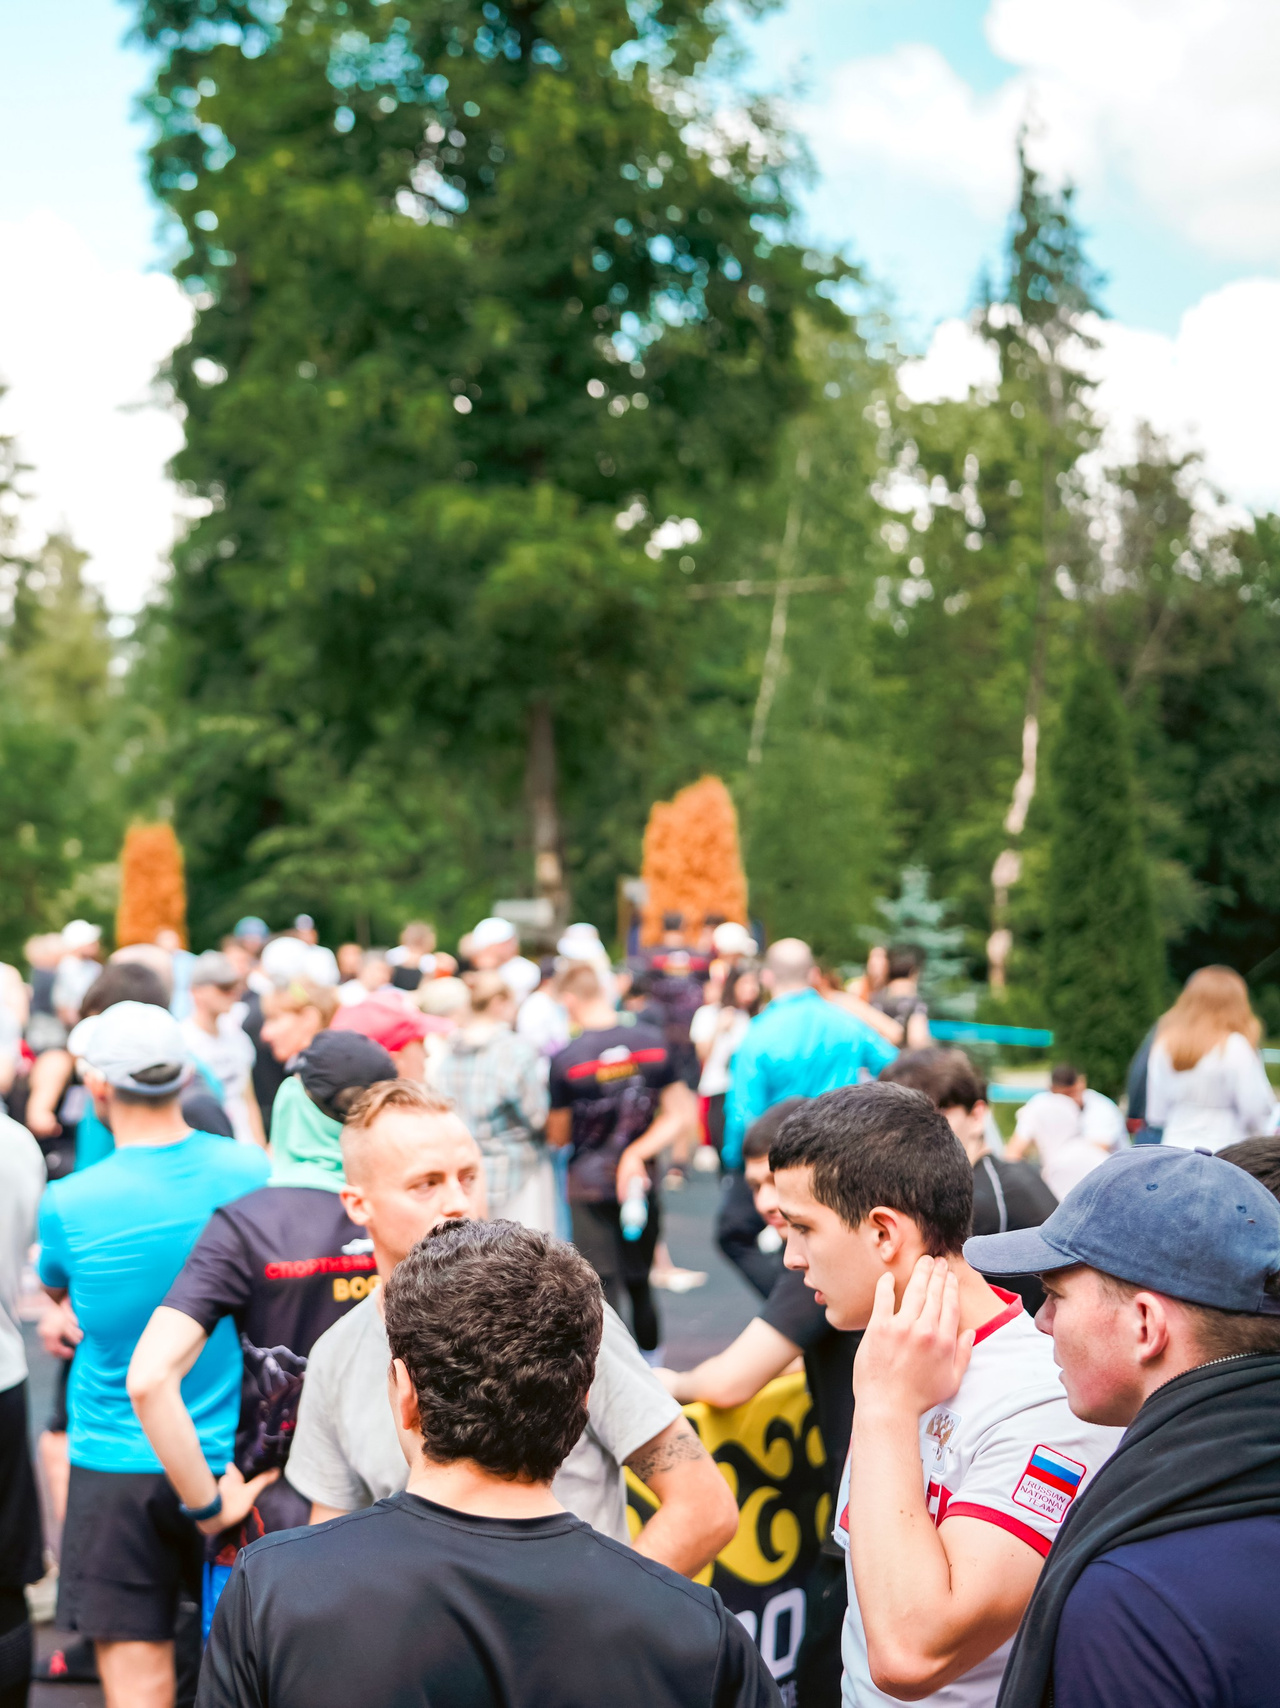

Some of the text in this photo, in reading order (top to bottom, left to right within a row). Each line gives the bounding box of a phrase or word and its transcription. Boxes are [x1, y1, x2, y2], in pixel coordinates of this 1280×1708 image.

[1020, 1485, 1063, 1511] NATIONAL
[1026, 1480, 1067, 1504] RUSSIAN
[1028, 1497, 1055, 1513] TEAM
